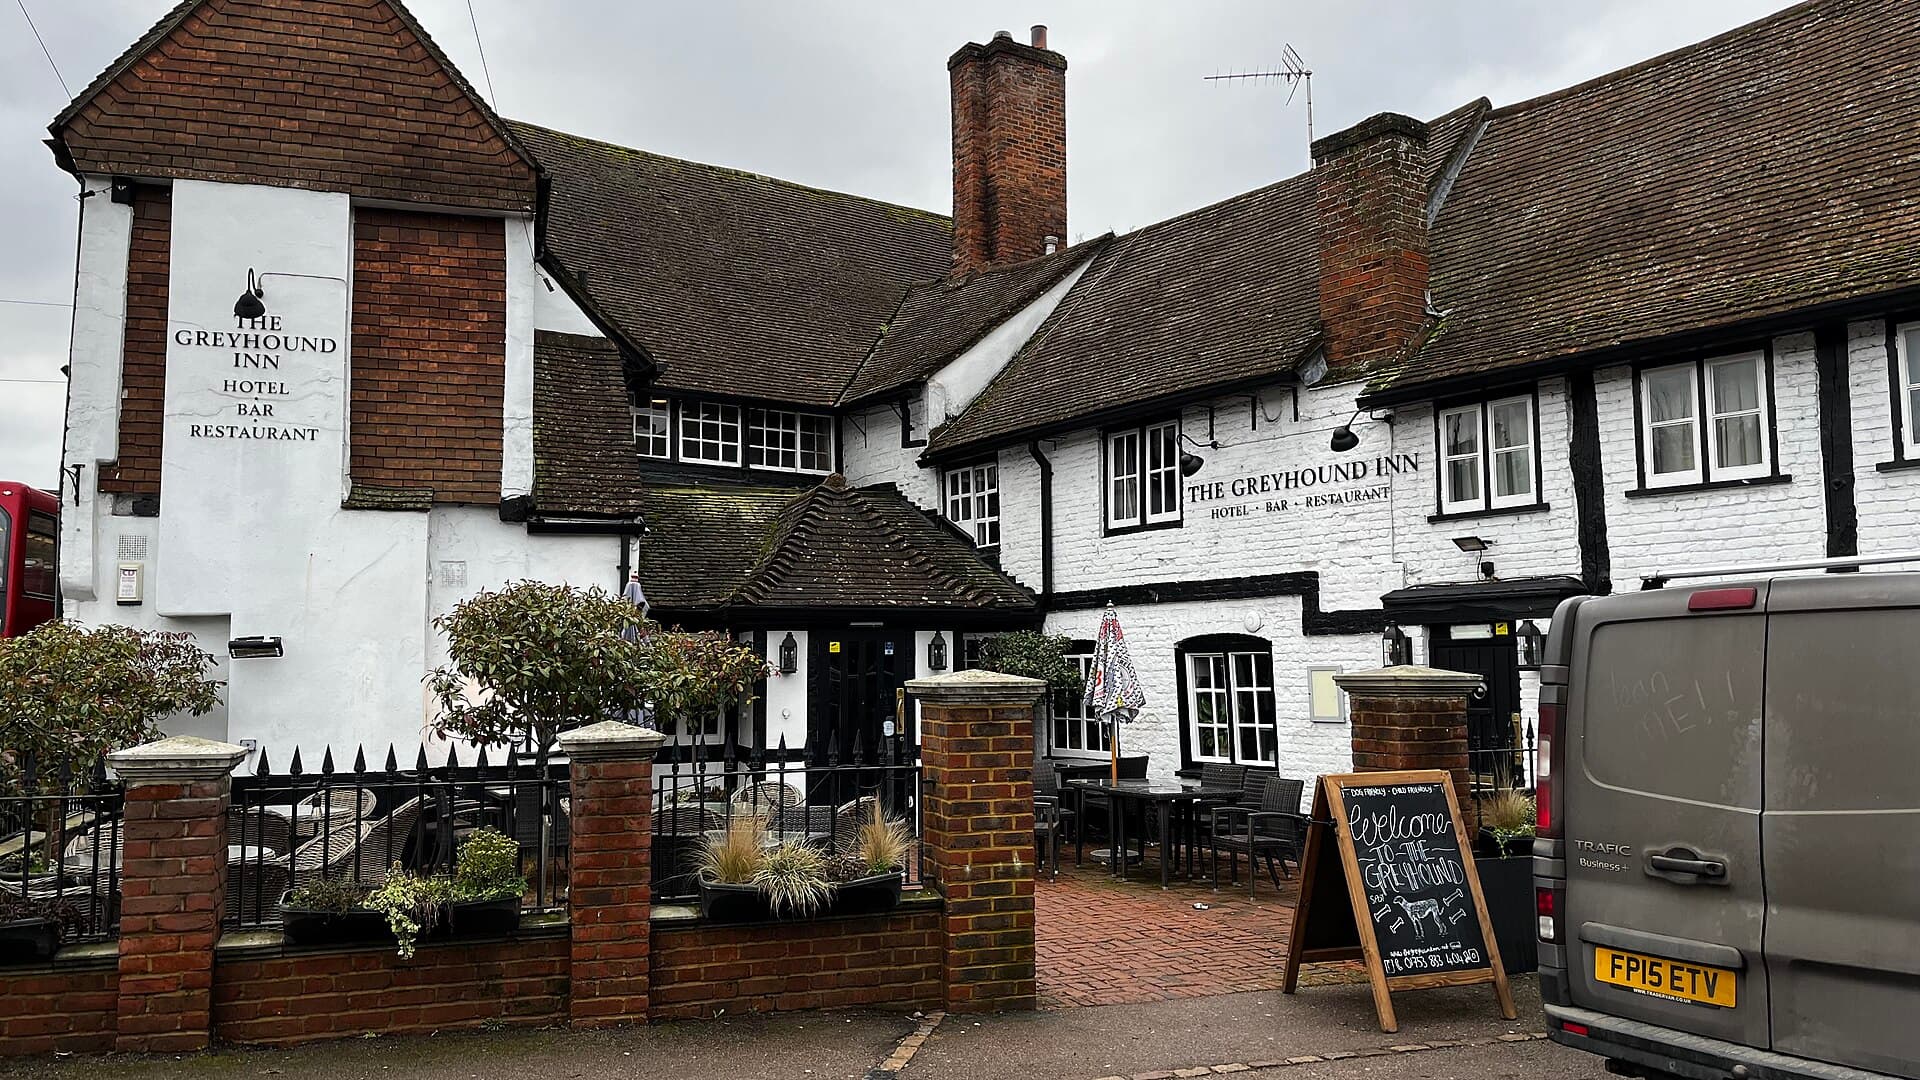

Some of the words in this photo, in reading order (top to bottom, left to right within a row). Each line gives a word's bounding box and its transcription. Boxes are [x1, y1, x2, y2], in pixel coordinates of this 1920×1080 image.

[236, 315, 282, 331] THE
[175, 330, 337, 353] GREYHOUND
[233, 352, 280, 369] INN
[223, 379, 290, 395] HOTEL
[237, 403, 274, 417] BAR
[190, 424, 319, 441] RESTAURANT
[1188, 481, 1225, 503] THE
[1231, 460, 1367, 497] GREYHOUND
[1375, 452, 1419, 477] INN
[1211, 505, 1250, 519] HOTEL
[1265, 499, 1289, 513] BAR
[1305, 486, 1391, 508] RESTAURANT
[1350, 788, 1364, 797] DOG
[1348, 804, 1452, 846] Welcome
[1369, 843, 1395, 864] TO
[1399, 840, 1435, 862] THE
[1574, 839, 1632, 856] TRAFIC
[1365, 857, 1464, 896] GREYHOUND
[1404, 956, 1428, 969] 01753
[1428, 954, 1444, 968] 833
[1610, 953, 1663, 988] FP15
[1670, 964, 1719, 998] ETV
